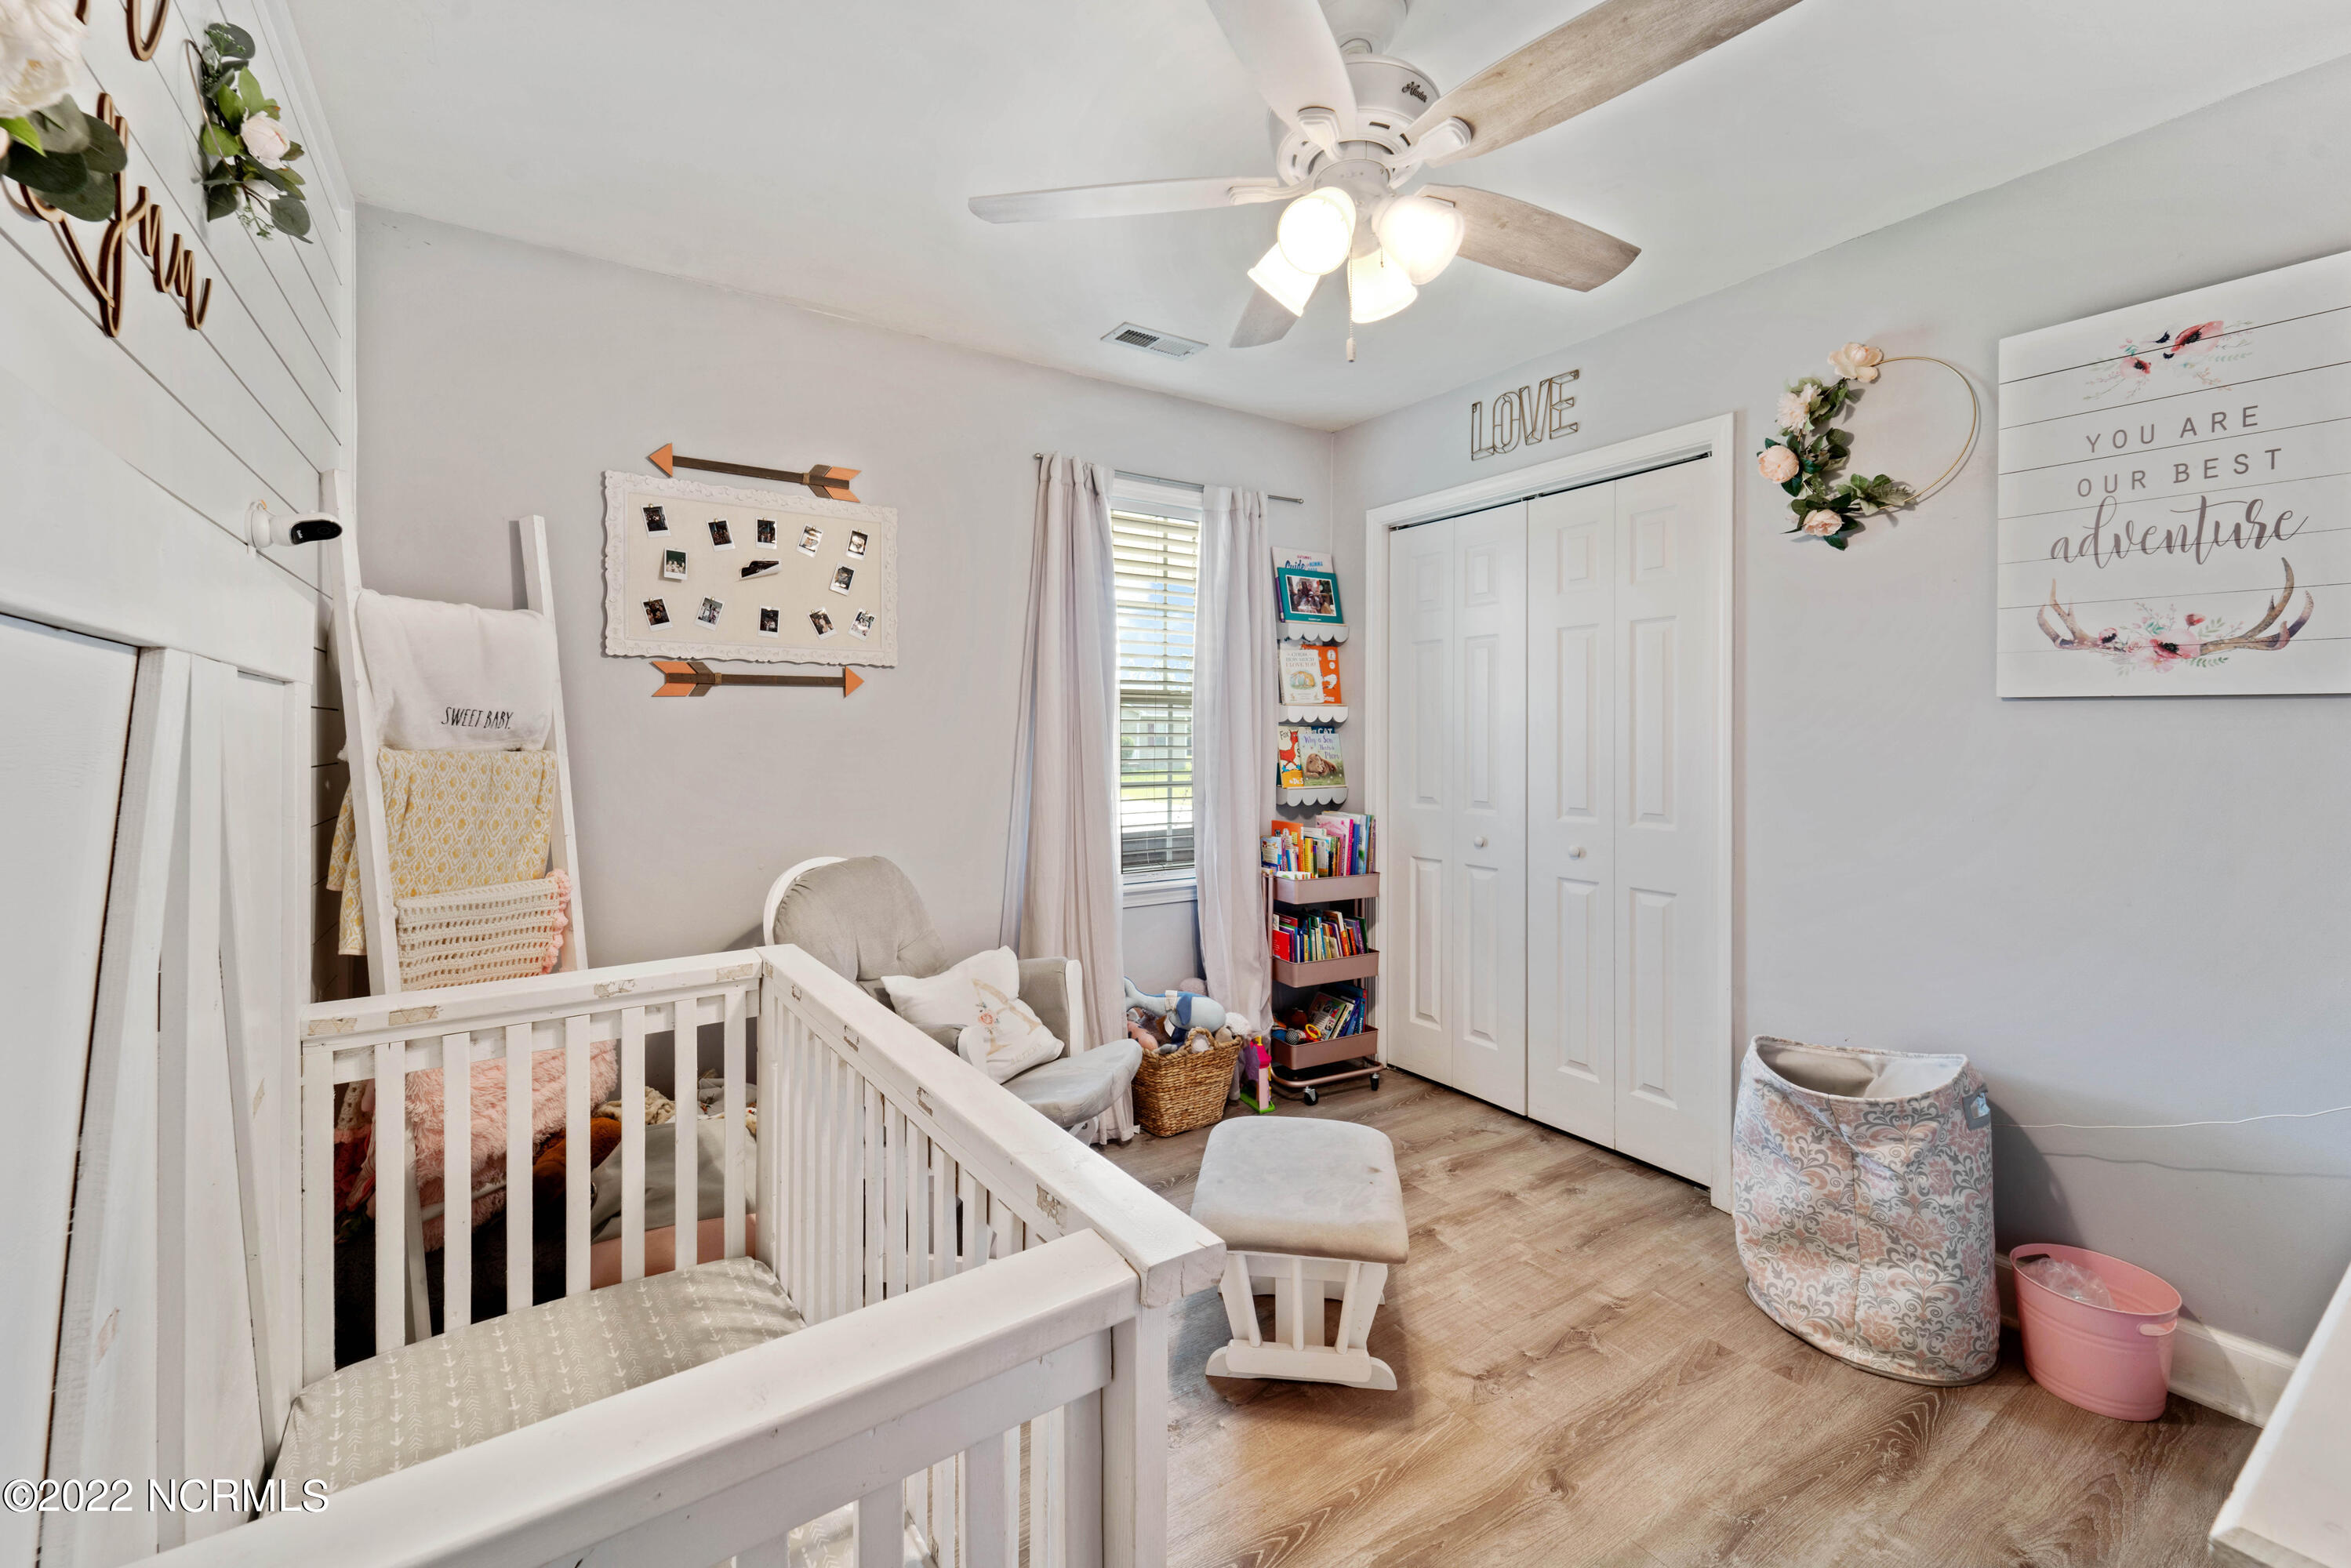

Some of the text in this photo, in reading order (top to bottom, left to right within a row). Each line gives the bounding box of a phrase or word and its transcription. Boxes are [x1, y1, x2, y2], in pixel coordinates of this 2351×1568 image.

[1471, 369, 1579, 461] LOVE
[2086, 405, 2258, 453] YOU ARE
[2077, 448, 2282, 497] OUR BEST
[2050, 495, 2309, 569] adventure
[441, 706, 483, 728] SWEET
